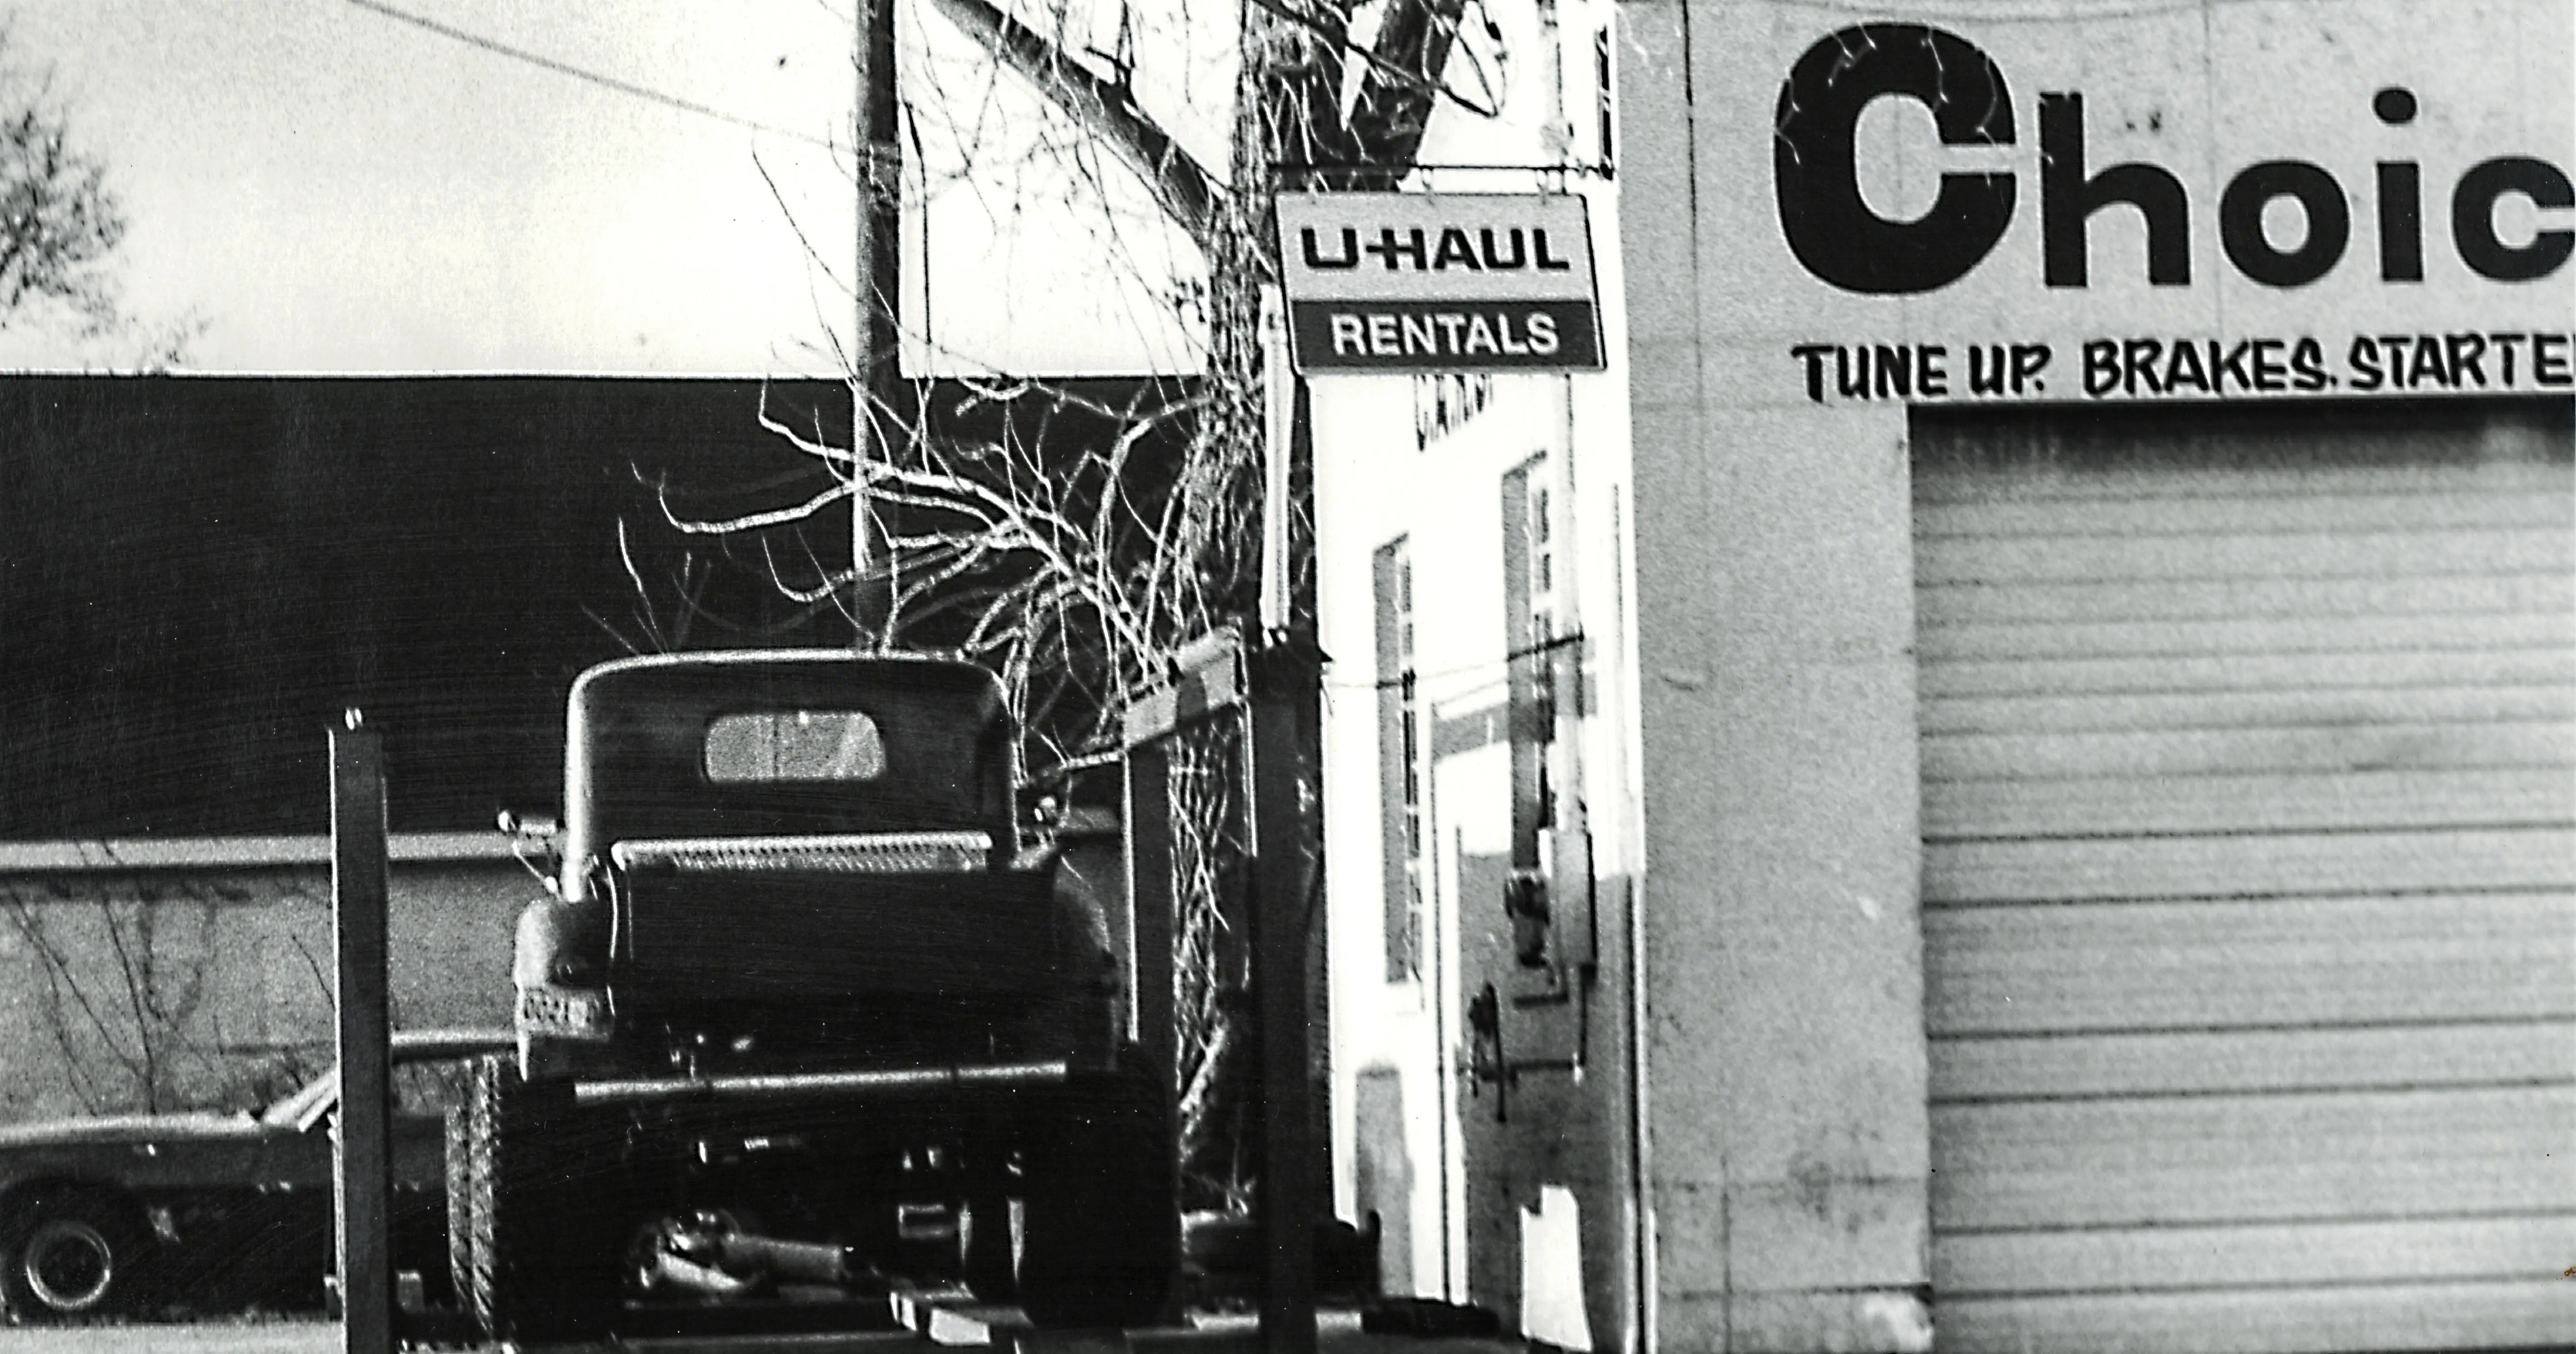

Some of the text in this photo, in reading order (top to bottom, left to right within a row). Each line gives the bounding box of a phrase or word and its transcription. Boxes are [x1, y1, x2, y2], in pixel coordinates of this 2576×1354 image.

[1300, 227, 1571, 271] U-HAUL
[1330, 313, 1559, 356] RENTALS
[1790, 344, 1949, 403] TUNE
[1968, 344, 2052, 396] UP.
[2347, 333, 2576, 392] STARTE
